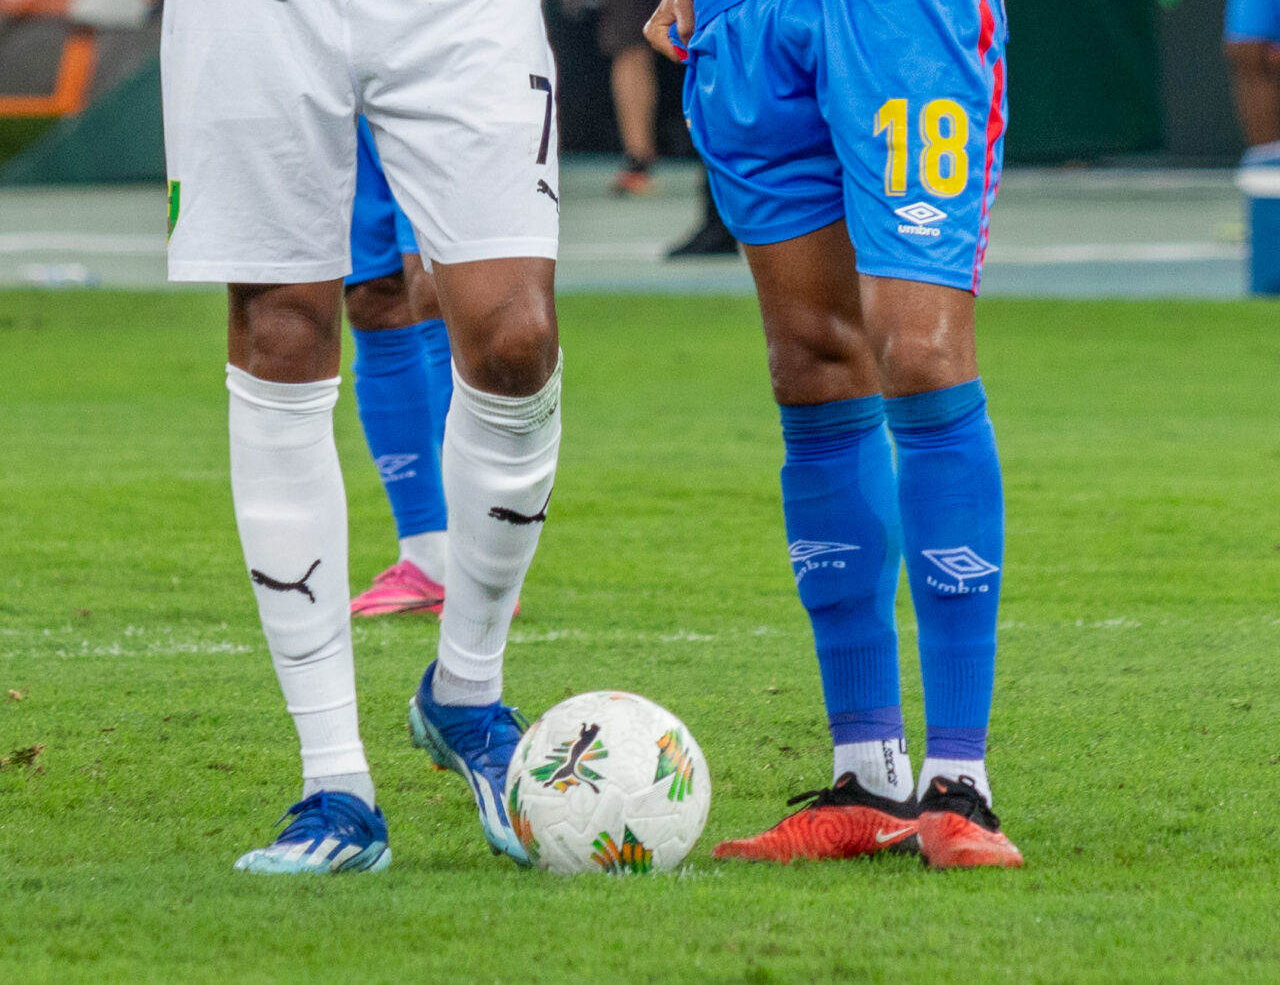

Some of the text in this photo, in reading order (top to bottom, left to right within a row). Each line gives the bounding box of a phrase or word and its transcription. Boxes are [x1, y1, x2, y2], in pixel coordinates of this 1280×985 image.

[529, 74, 553, 165] 7
[873, 98, 969, 198] 18
[897, 224, 941, 237] umbro
[926, 575, 989, 594] umbro
